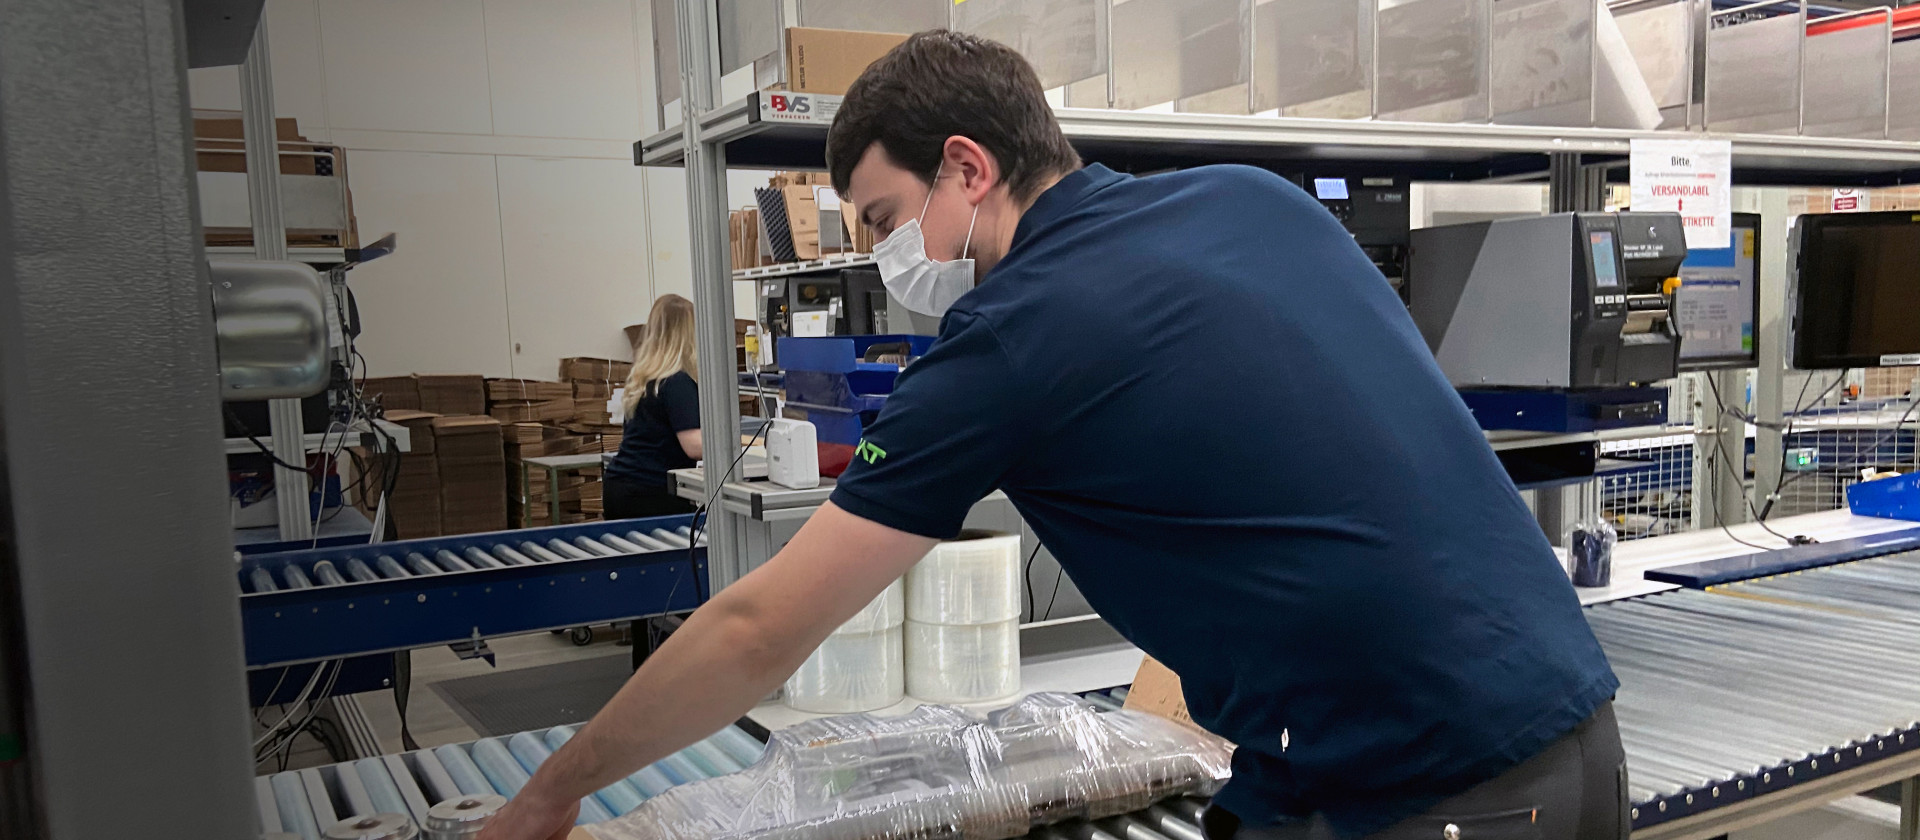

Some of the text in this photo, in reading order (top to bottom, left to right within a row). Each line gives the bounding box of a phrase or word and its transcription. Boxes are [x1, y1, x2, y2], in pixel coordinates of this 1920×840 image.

[771, 94, 811, 113] BVS
[1671, 156, 1692, 168] Bitte,
[1651, 185, 1709, 196] VERSANDLABEL
